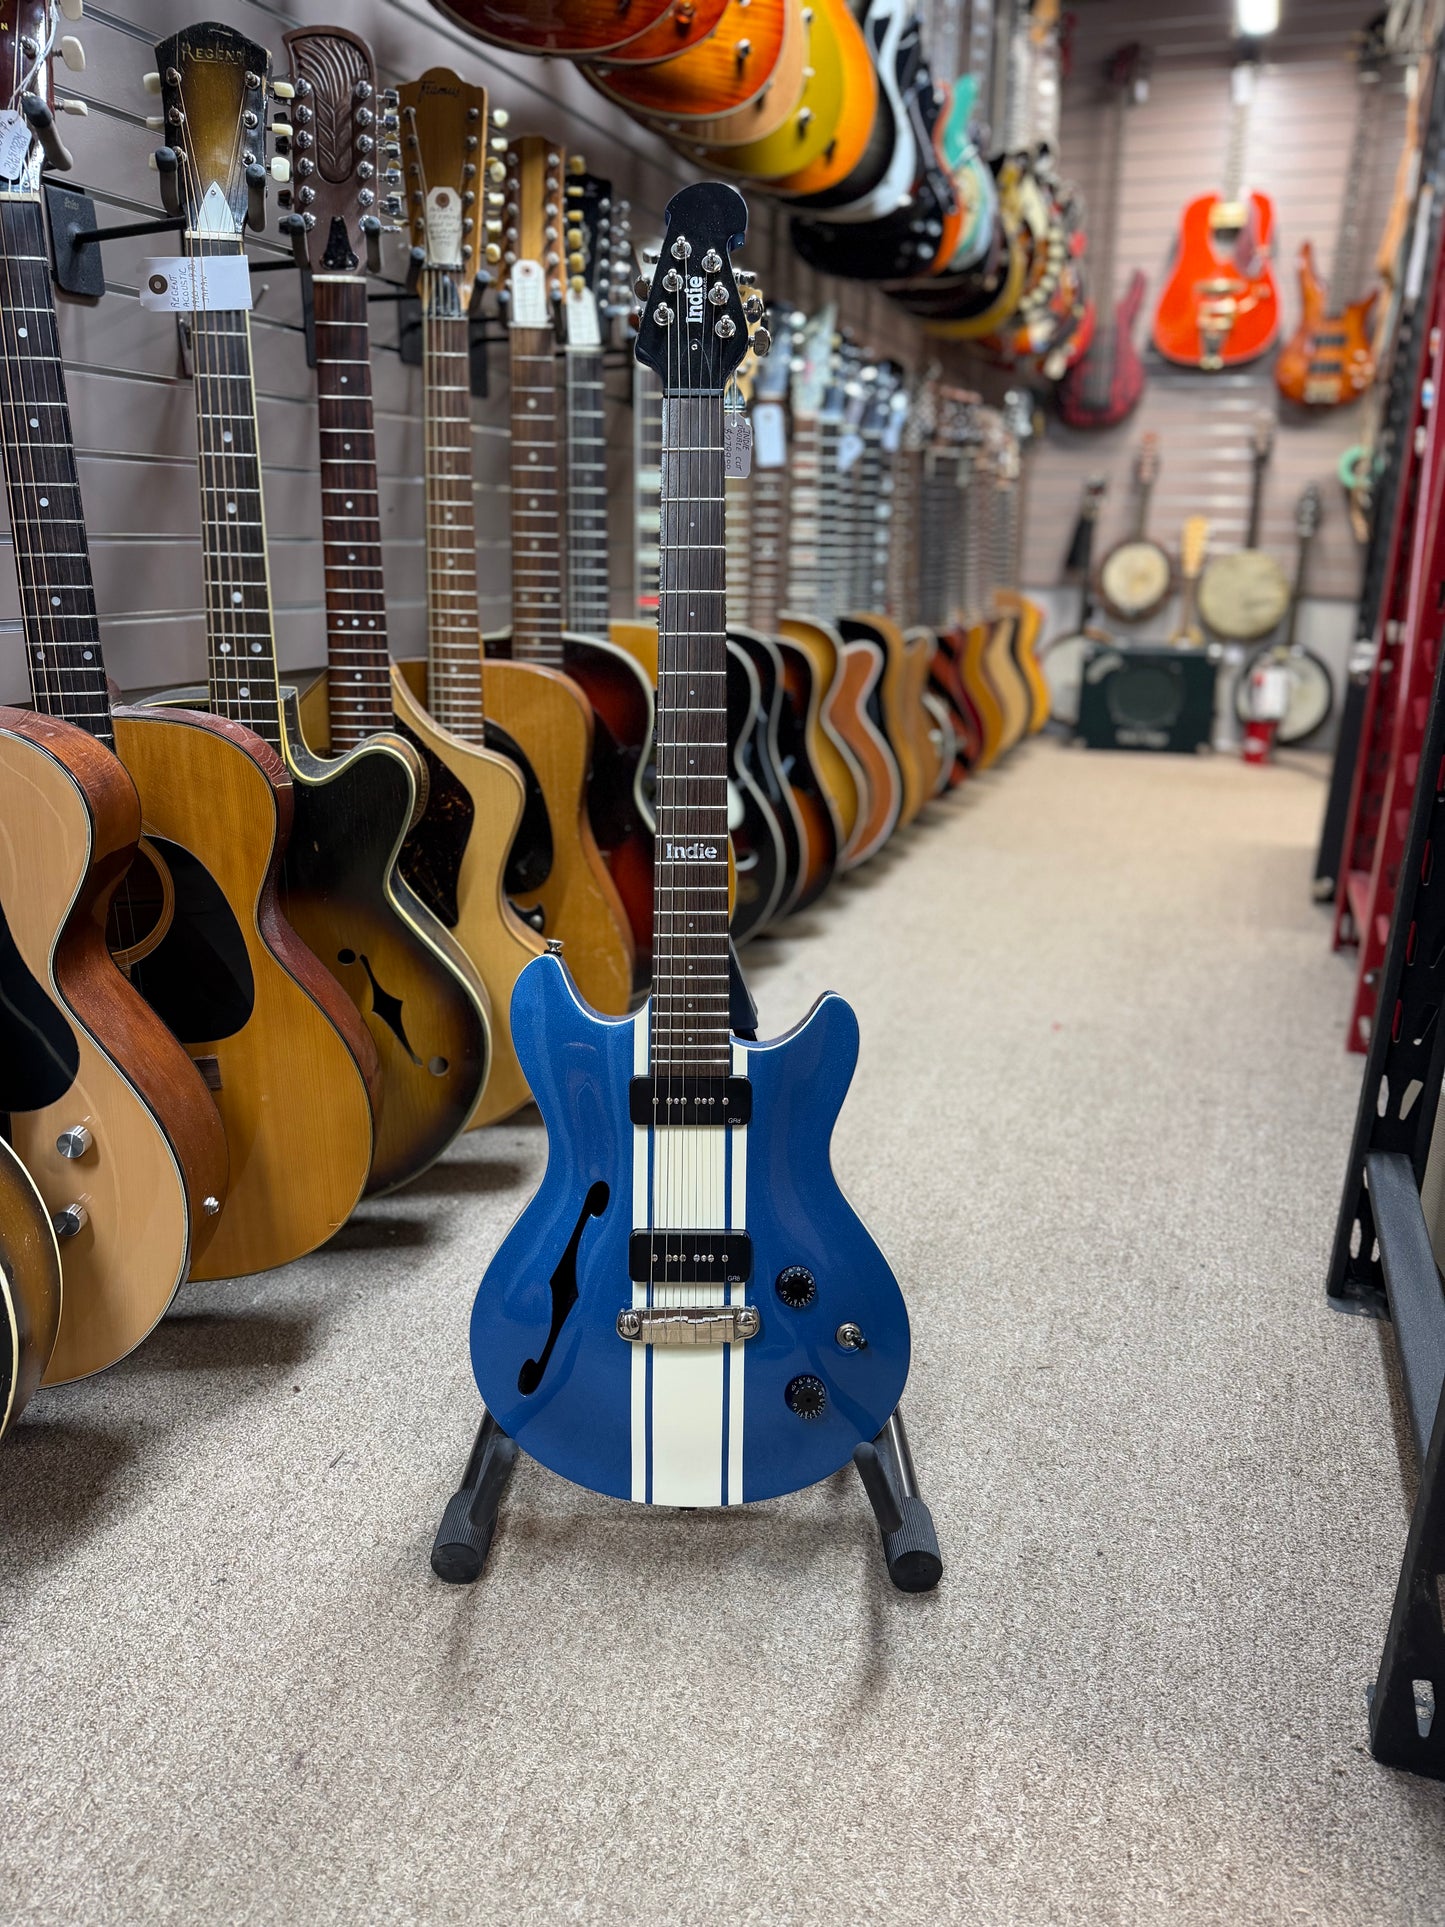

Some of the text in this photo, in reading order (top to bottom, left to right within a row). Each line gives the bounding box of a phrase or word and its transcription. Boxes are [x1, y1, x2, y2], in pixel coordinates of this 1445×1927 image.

[169, 274, 180, 309] REGENT
[178, 266, 190, 308] ACOUSTIC
[685, 276, 703, 323] Indie
[735, 424, 744, 452] DOUBLE
[742, 427, 751, 451] INDIE
[735, 456, 743, 472] CUT
[665, 842, 718, 860] Indie
